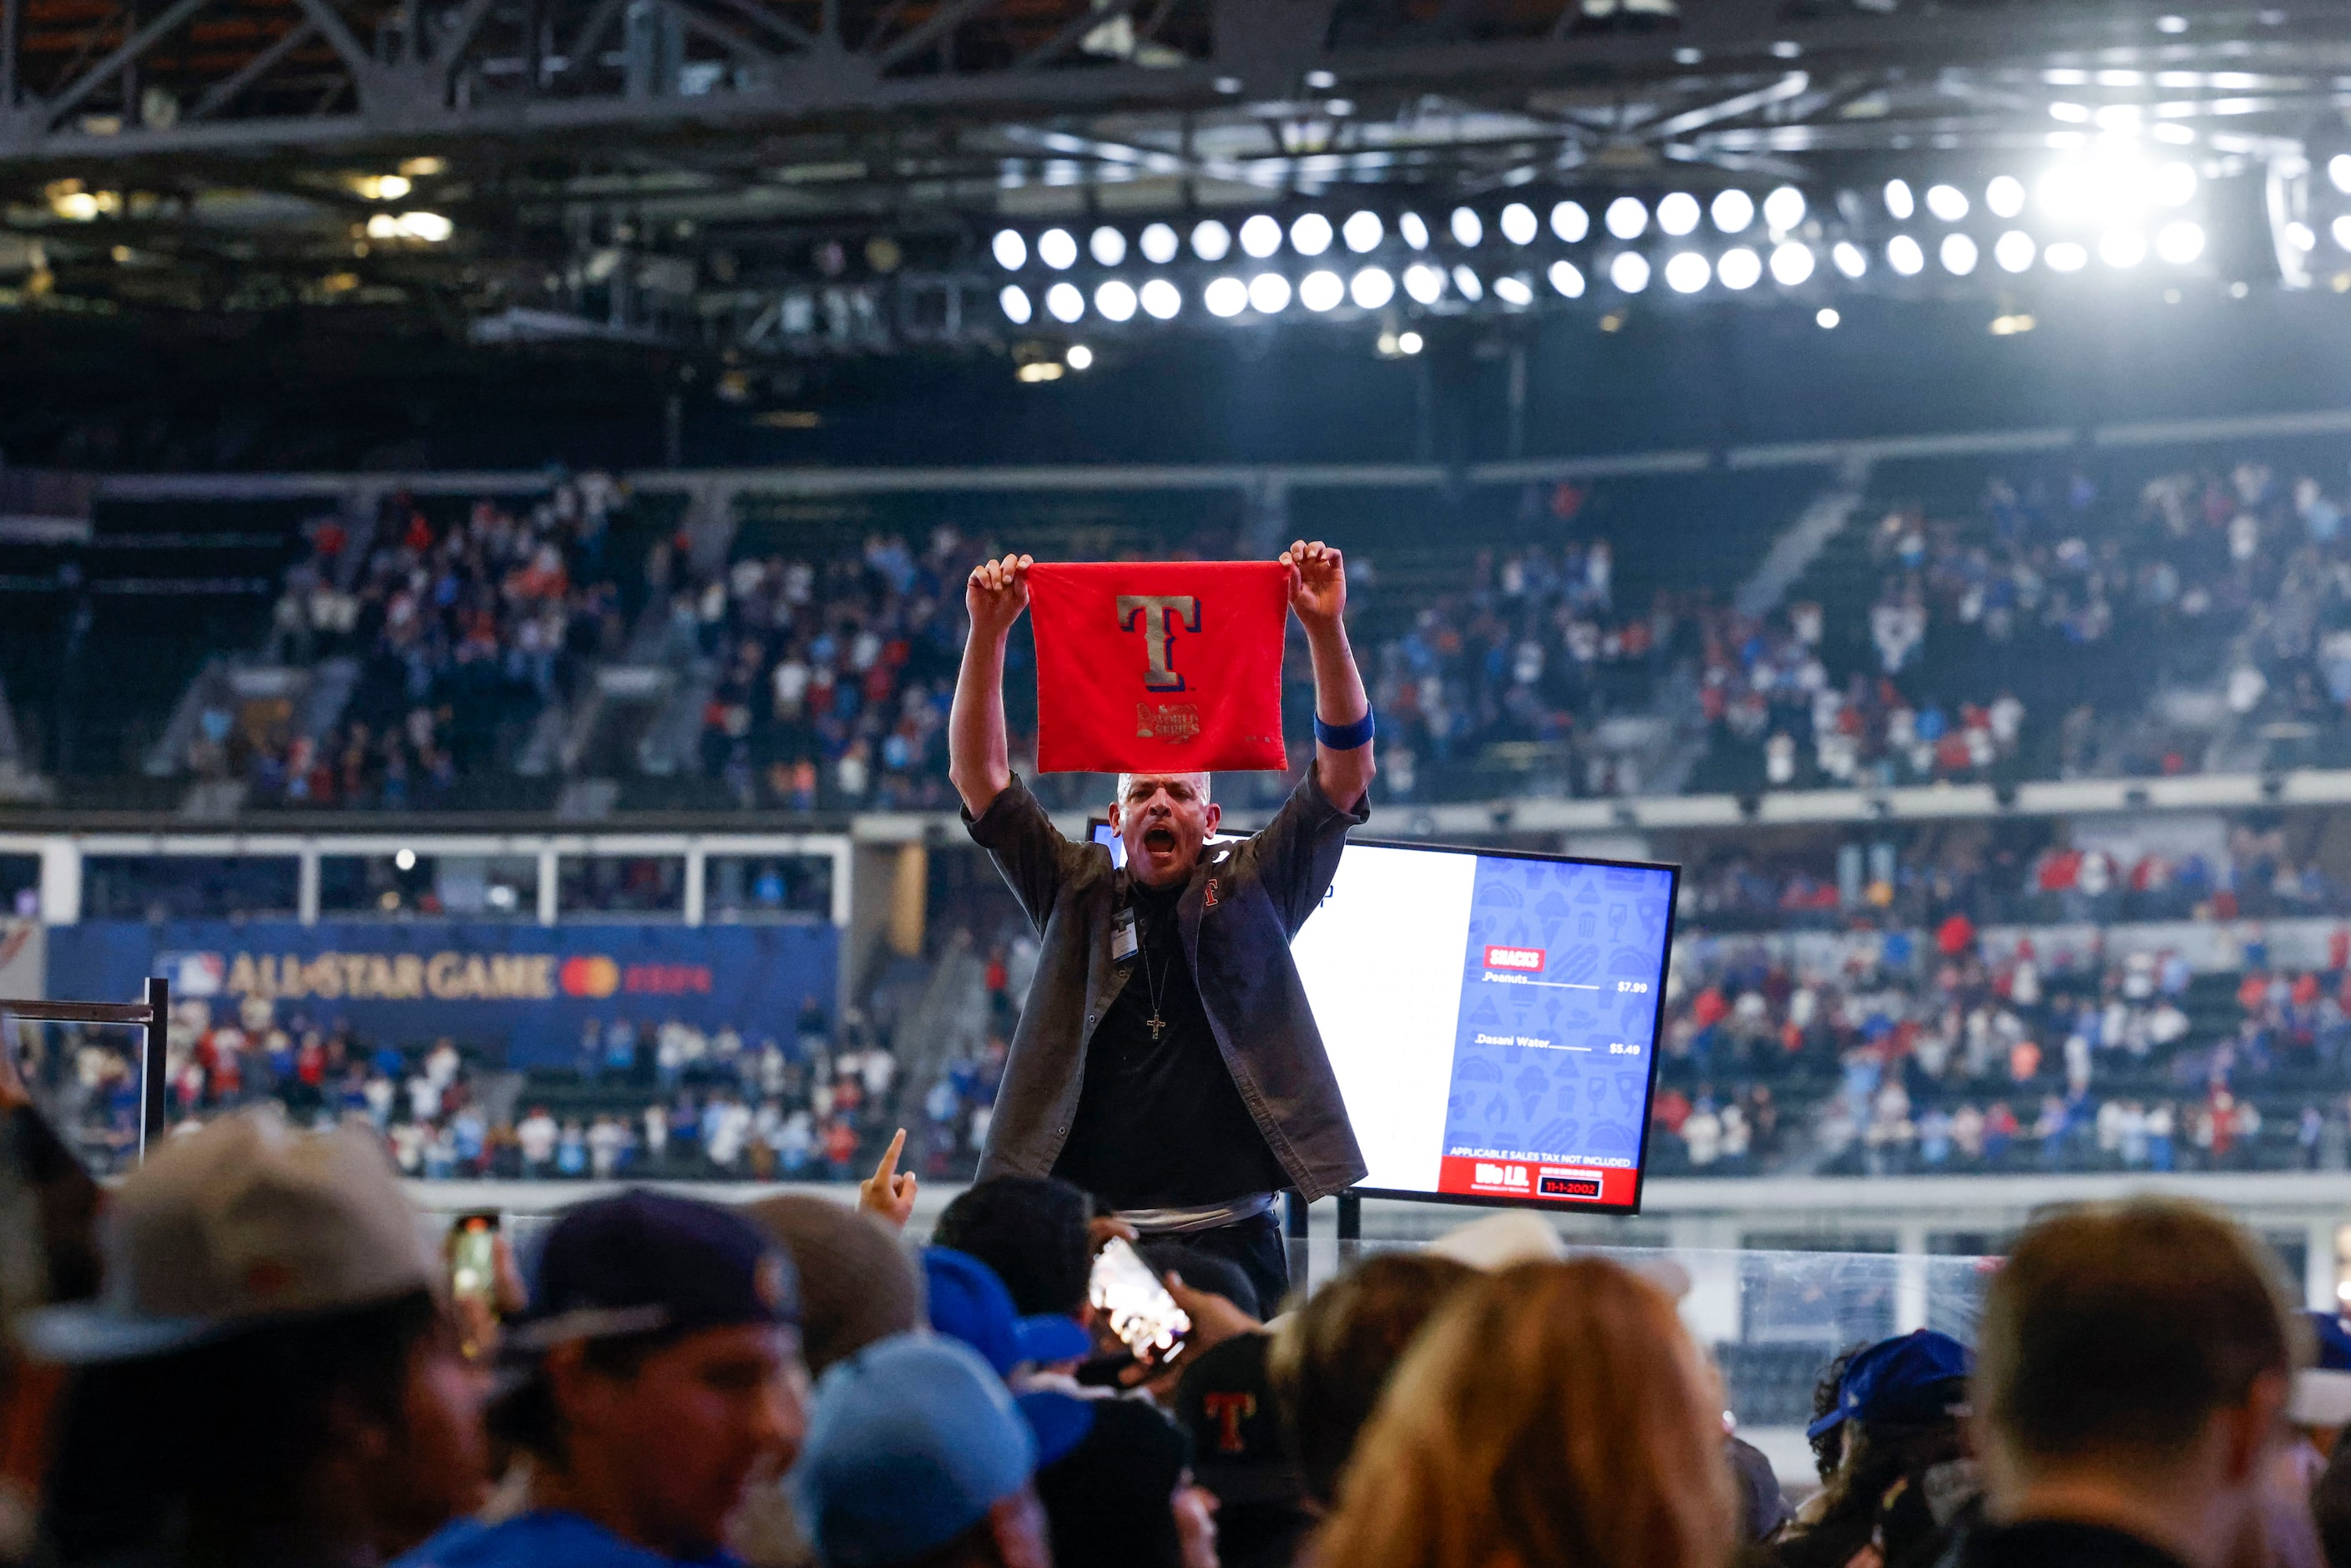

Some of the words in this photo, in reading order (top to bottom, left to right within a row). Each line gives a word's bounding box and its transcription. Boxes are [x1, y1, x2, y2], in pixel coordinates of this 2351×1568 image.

[1116, 594, 1201, 692] T
[1489, 948, 1540, 968] SNACKS
[427, 950, 558, 1000] GAME
[1617, 980, 1648, 994] $7.99
[1609, 1042, 1641, 1055] $5.49
[1450, 1146, 1509, 1160] APPLICABLE
[1509, 1151, 1540, 1162] SALES
[1541, 1153, 1560, 1163] TAX
[1562, 1155, 1582, 1165] NOT
[1583, 1156, 1631, 1168] INCLUDED
[1545, 1181, 1596, 1196] 11-1-2002
[1204, 1392, 1256, 1451] T
